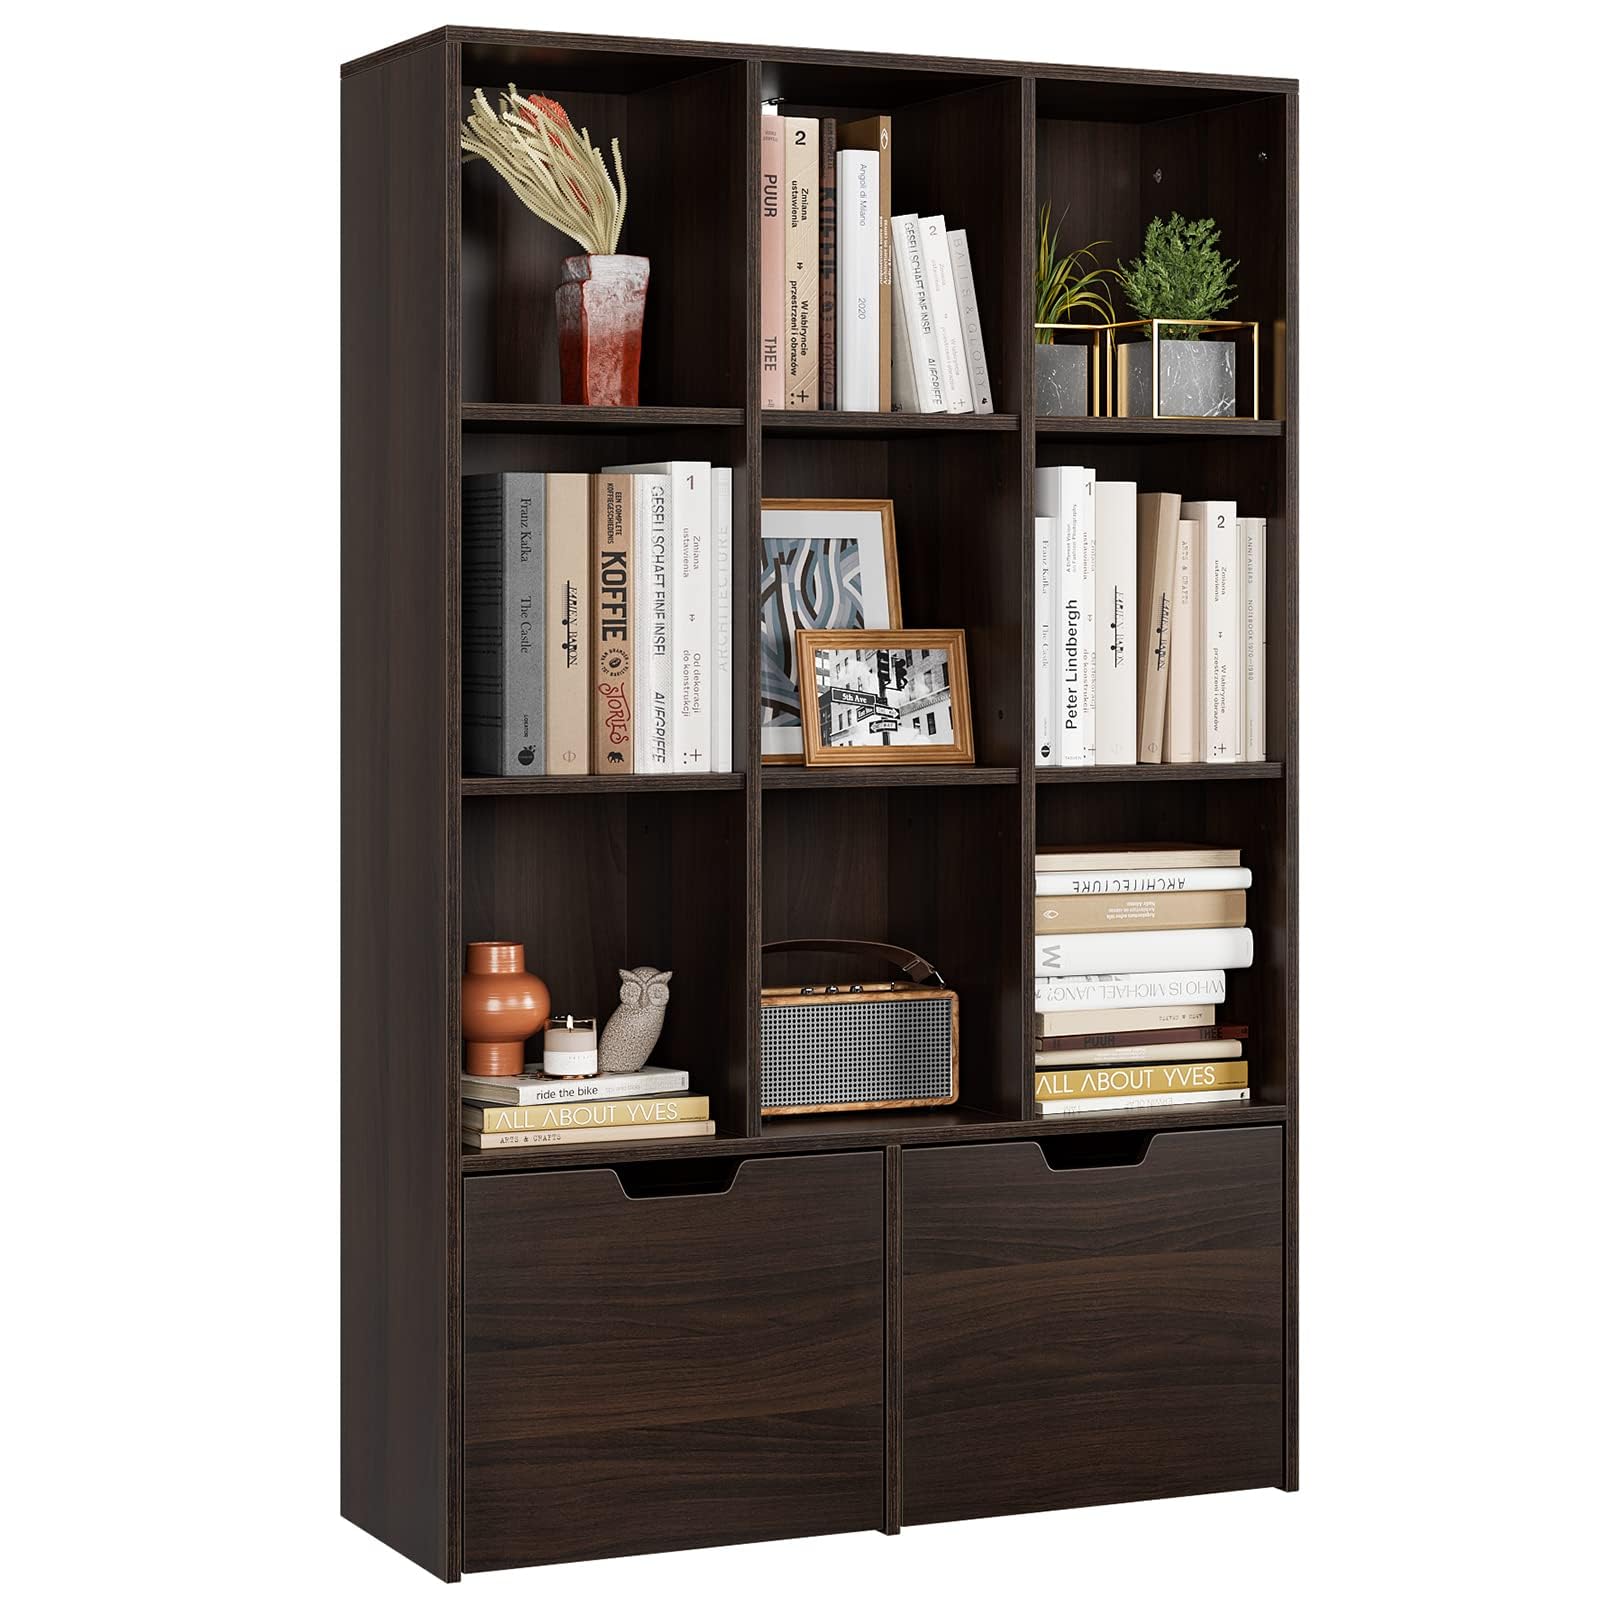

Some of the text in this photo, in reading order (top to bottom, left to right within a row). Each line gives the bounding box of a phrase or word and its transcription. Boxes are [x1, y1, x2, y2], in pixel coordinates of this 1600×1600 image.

[794, 130, 806, 146] 2
[858, 164, 867, 190] Angoli
[764, 174, 778, 218] PUUR
[801, 188, 809, 221] Zmiana
[859, 201, 867, 226] Milano
[928, 226, 937, 236] 2
[789, 280, 798, 330] przestrzeni
[801, 300, 808, 311] W
[858, 298, 866, 320] 2020
[764, 336, 777, 371] THEE
[790, 337, 798, 376] obrazów
[686, 475, 694, 490] 1
[1085, 482, 1092, 496] 1
[521, 498, 532, 562] Franz Kafka
[1217, 515, 1225, 528] 2
[682, 528, 690, 578] ustawienia
[602, 551, 627, 642] KOFFIE
[520, 596, 531, 653] The Castle
[1065, 600, 1080, 729] Peter Lindbergh
[681, 650, 691, 717] do konstrukcji
[692, 653, 701, 713] Od dekoracji
[598, 683, 630, 745] STORIES
[1047, 986, 1096, 1001] JANG?
[1169, 983, 1182, 996] IS
[1185, 980, 1224, 996] WHO
[536, 1088, 556, 1100] ride
[559, 1087, 575, 1097] the
[577, 1084, 598, 1096] bike
[1036, 1066, 1216, 1095] ALL ABOUT YVES
[496, 1103, 678, 1130] ALL ABOUT YVES
[500, 1135, 519, 1144] ARTS
[533, 1134, 561, 1142] CRAFTS
